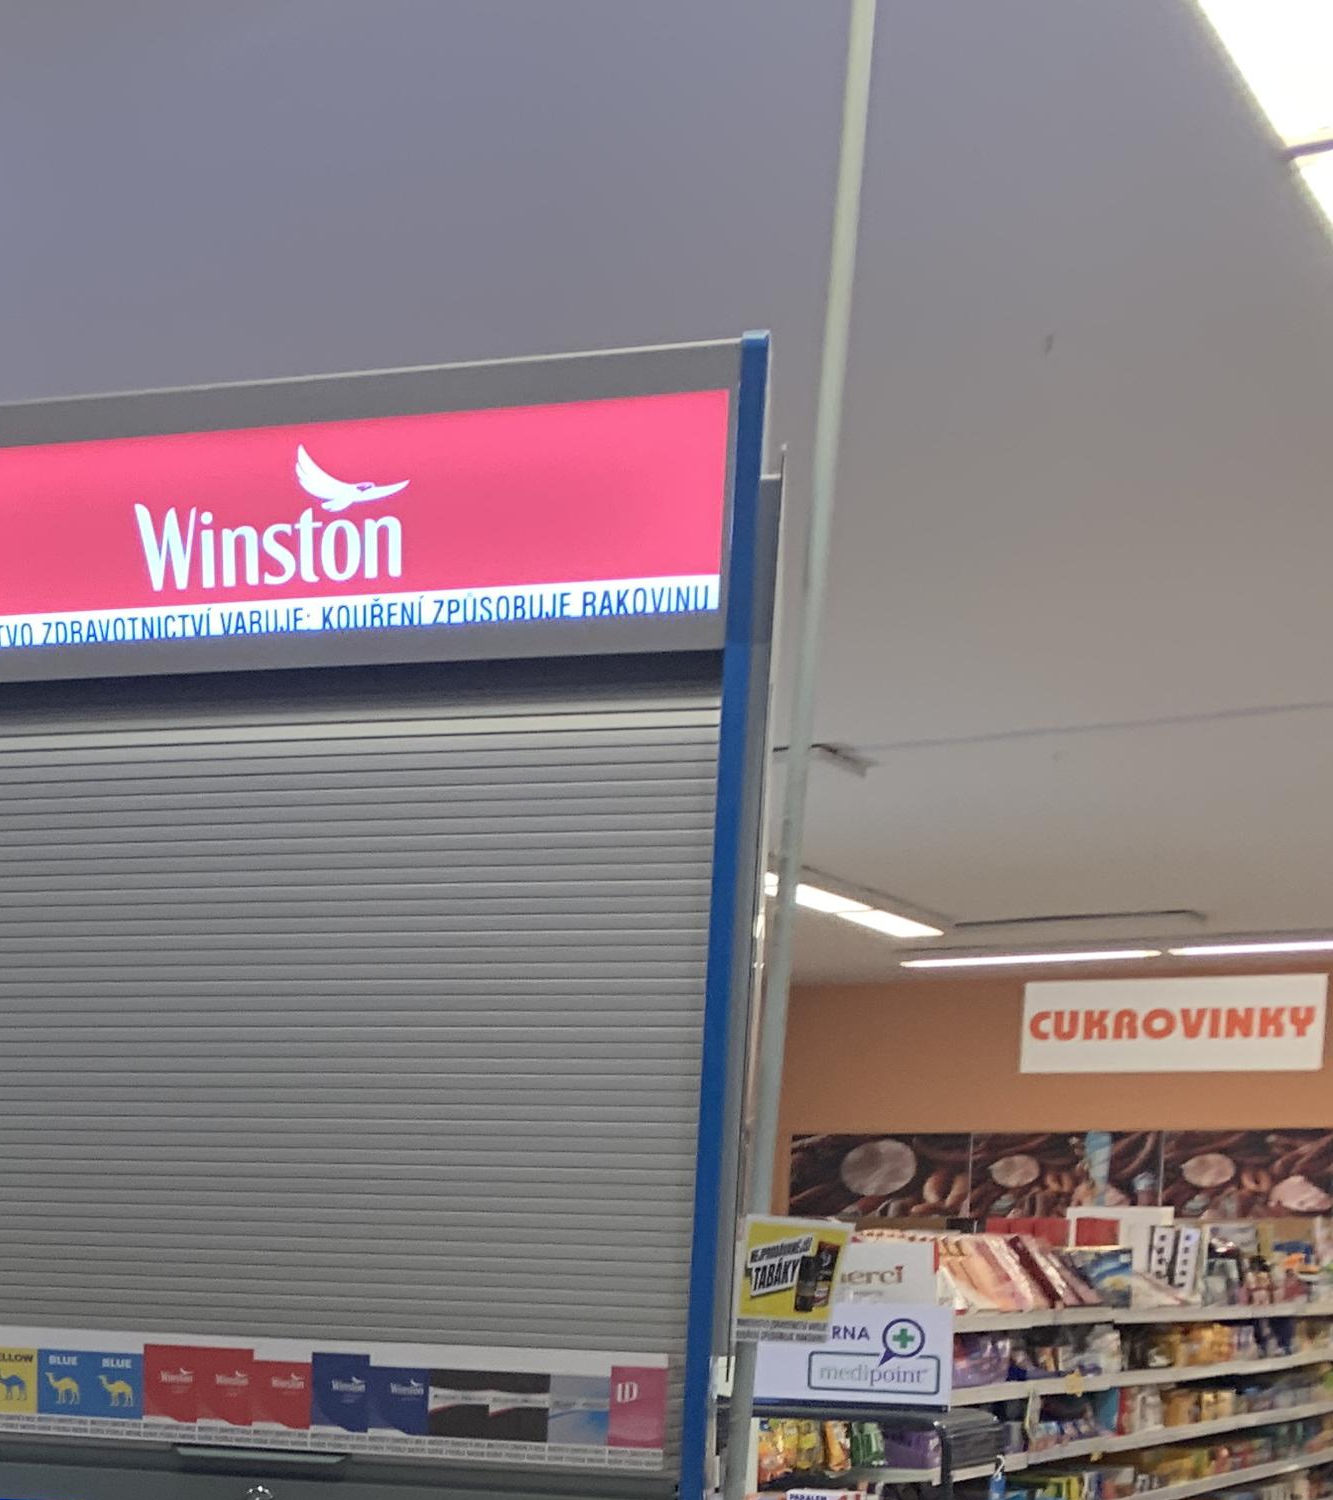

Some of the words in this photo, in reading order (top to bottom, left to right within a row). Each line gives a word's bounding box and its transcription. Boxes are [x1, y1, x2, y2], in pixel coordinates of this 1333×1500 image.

[134, 503, 403, 591] Winston
[43, 608, 212, 645] ZDRAVOTNICTVÍ
[321, 594, 424, 630] KOUŘENÍ
[432, 591, 572, 625] ZPŮSOBUJE
[582, 584, 710, 616] RAKOVINU
[1029, 1006, 1317, 1041] CUKROVINKY
[753, 1259, 801, 1292] TABÁKY
[832, 1325, 871, 1341] RNA
[48, 1355, 78, 1366] BLUE
[101, 1358, 132, 1369] BLUE
[819, 1362, 923, 1386] medipoint
